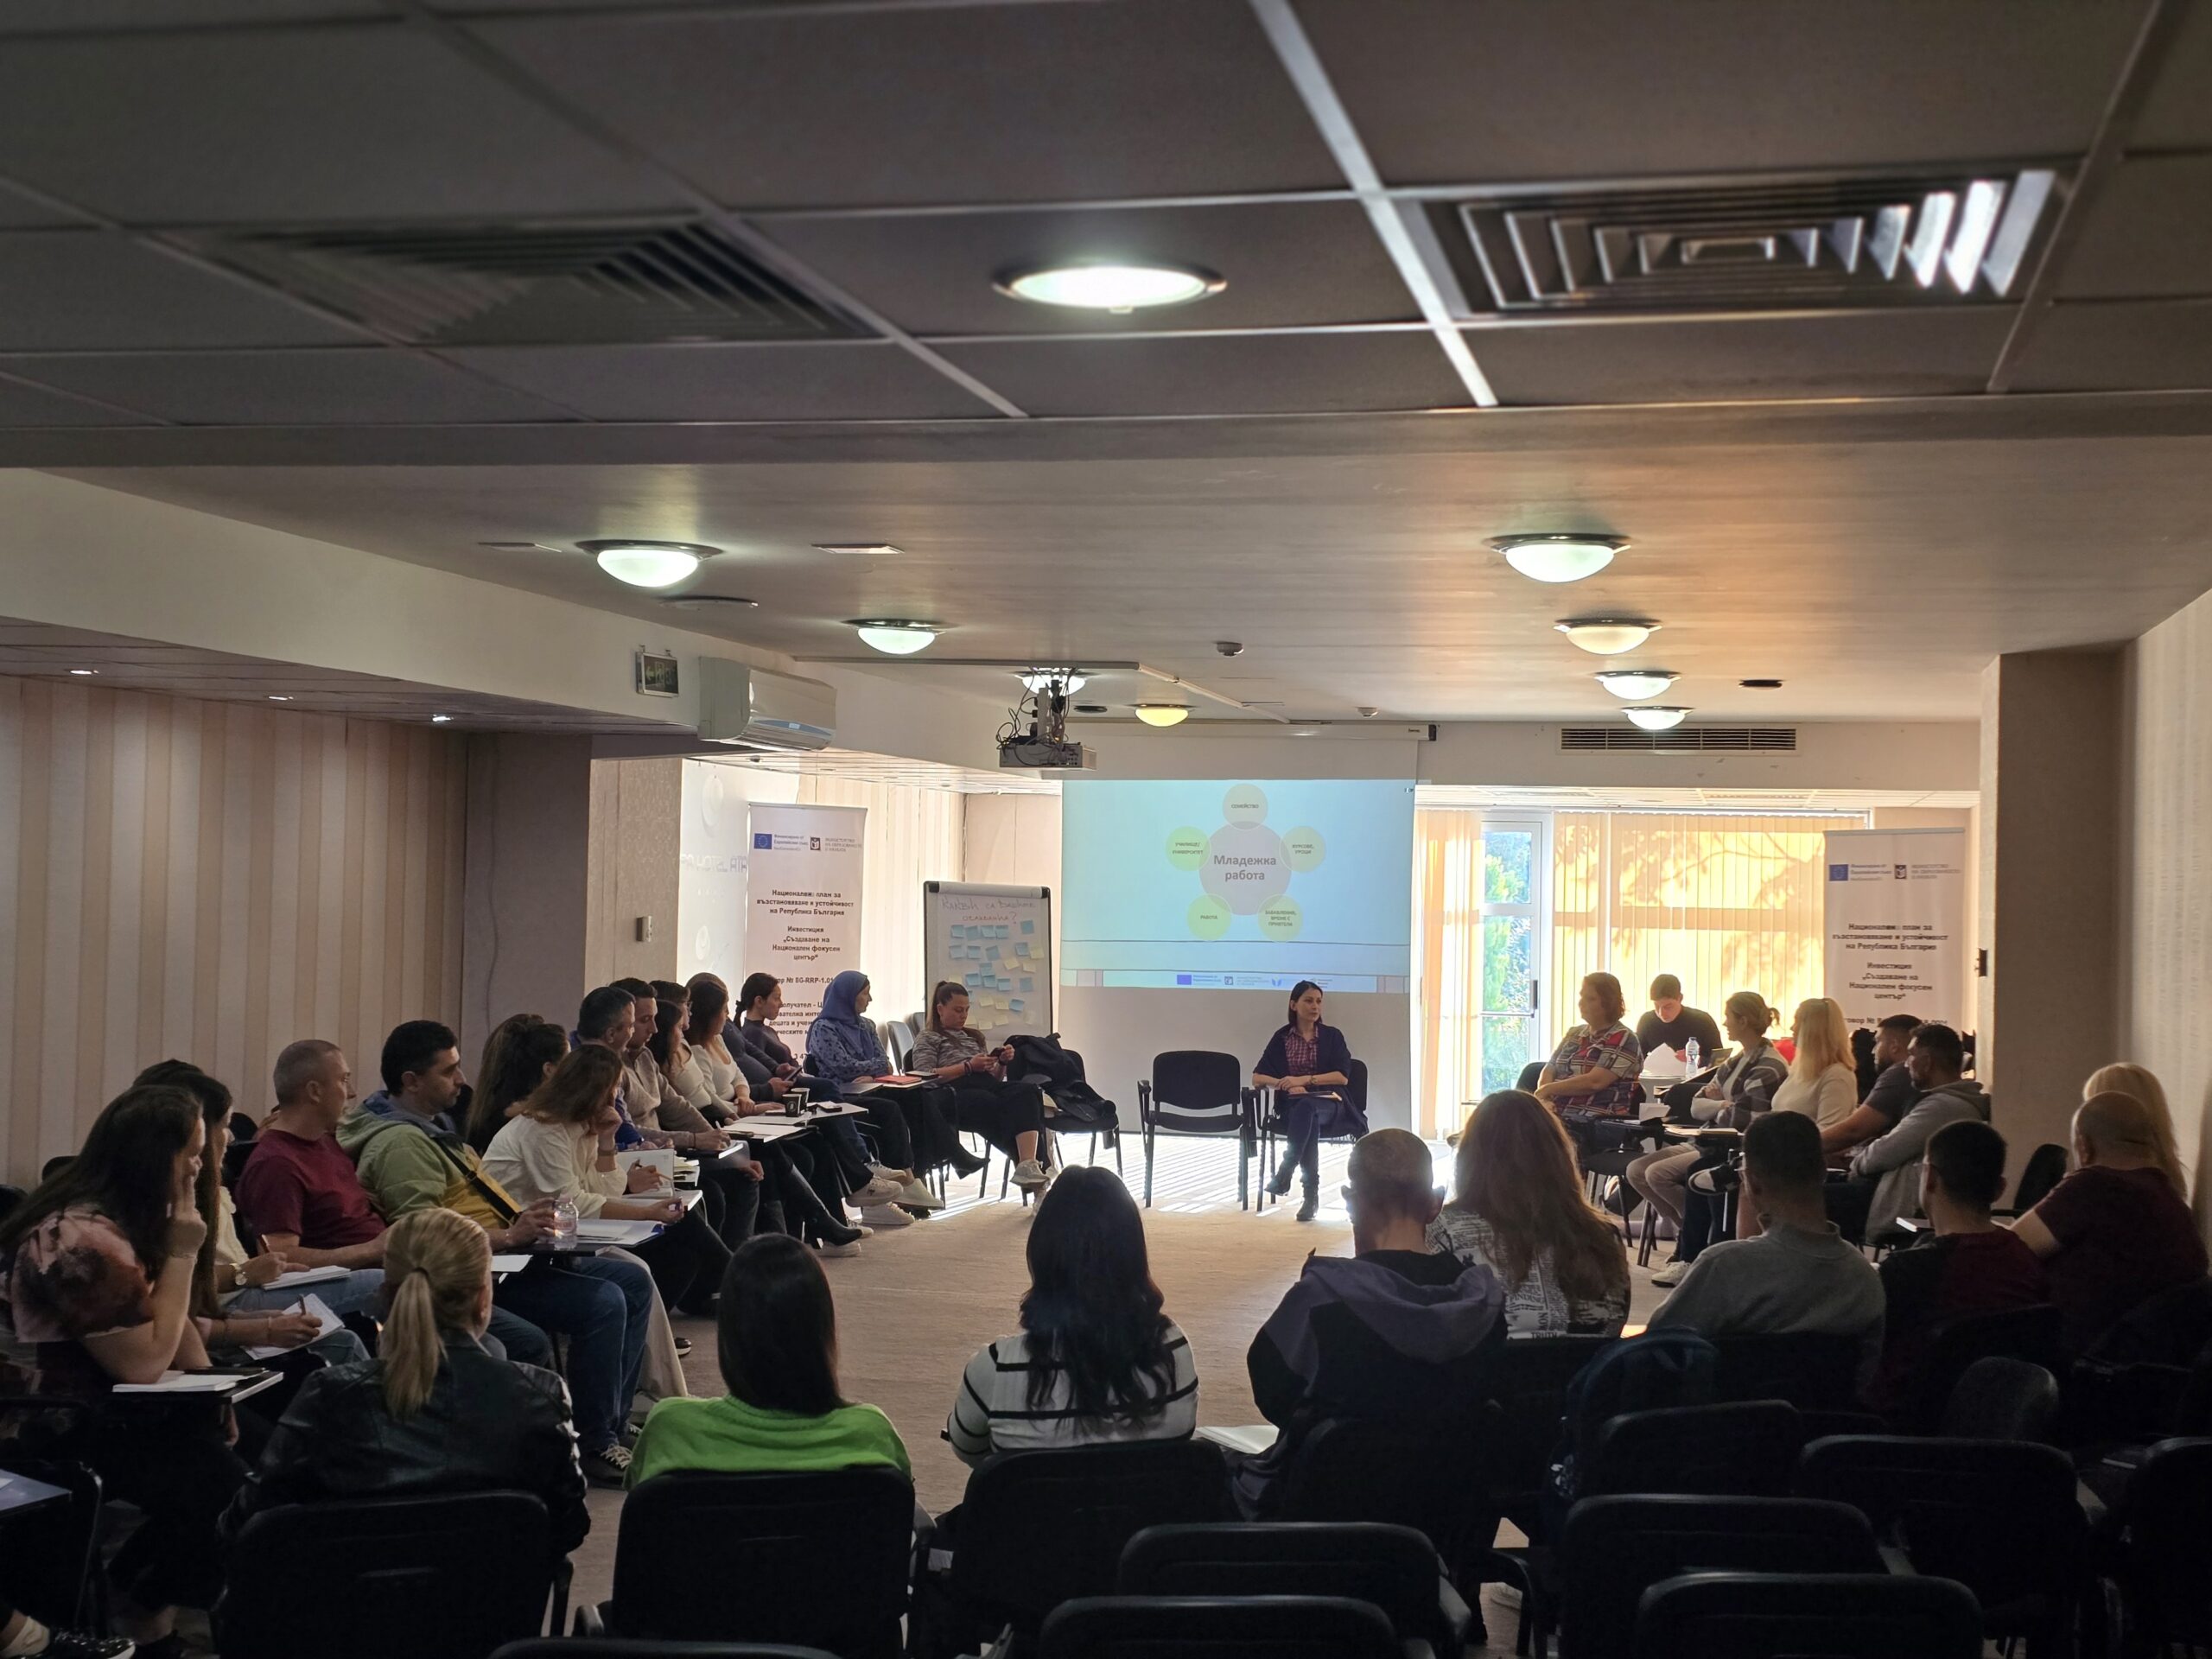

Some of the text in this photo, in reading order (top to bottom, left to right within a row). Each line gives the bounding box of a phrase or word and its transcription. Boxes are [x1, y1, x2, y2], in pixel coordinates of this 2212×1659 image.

[1213, 855, 1277, 868] Младежка
[1225, 869, 1265, 882] работа
[779, 908, 812, 916] Република
[814, 909, 845, 917] България
